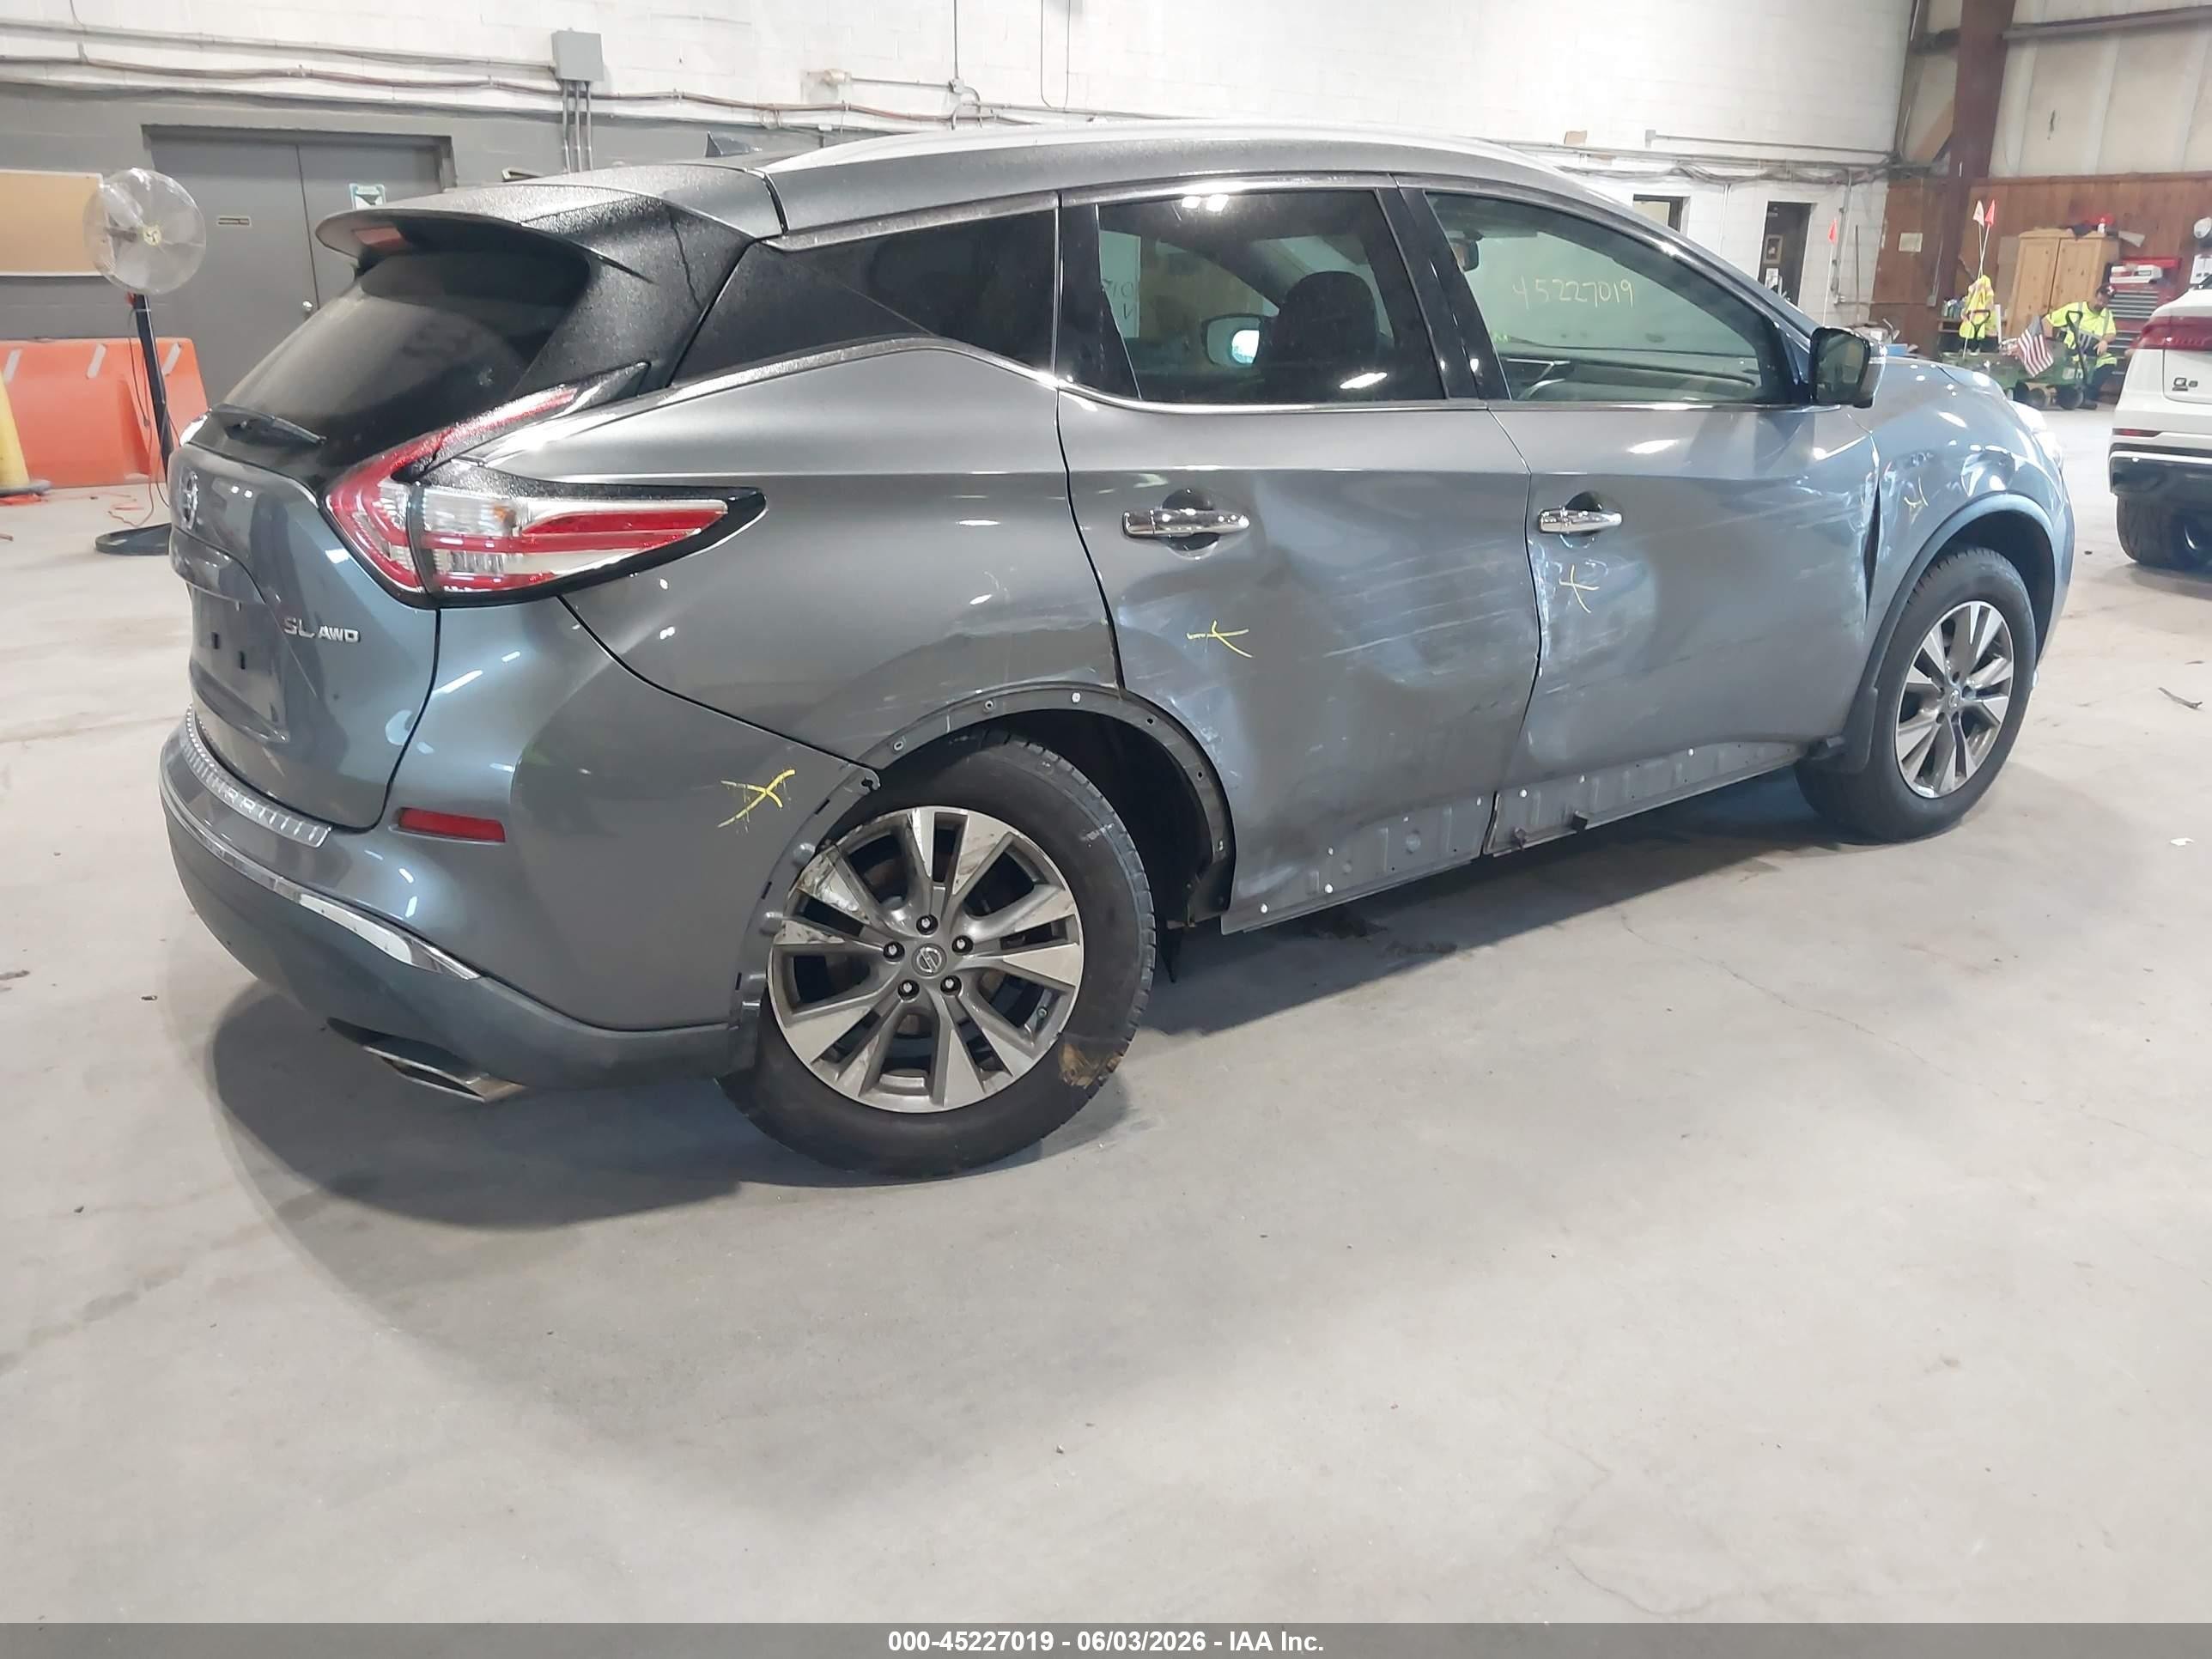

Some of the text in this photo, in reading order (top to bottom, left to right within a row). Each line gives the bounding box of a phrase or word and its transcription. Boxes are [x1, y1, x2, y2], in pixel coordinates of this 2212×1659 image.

[1512, 275, 1633, 309] 45227019
[283, 617, 360, 643] SL AWD
